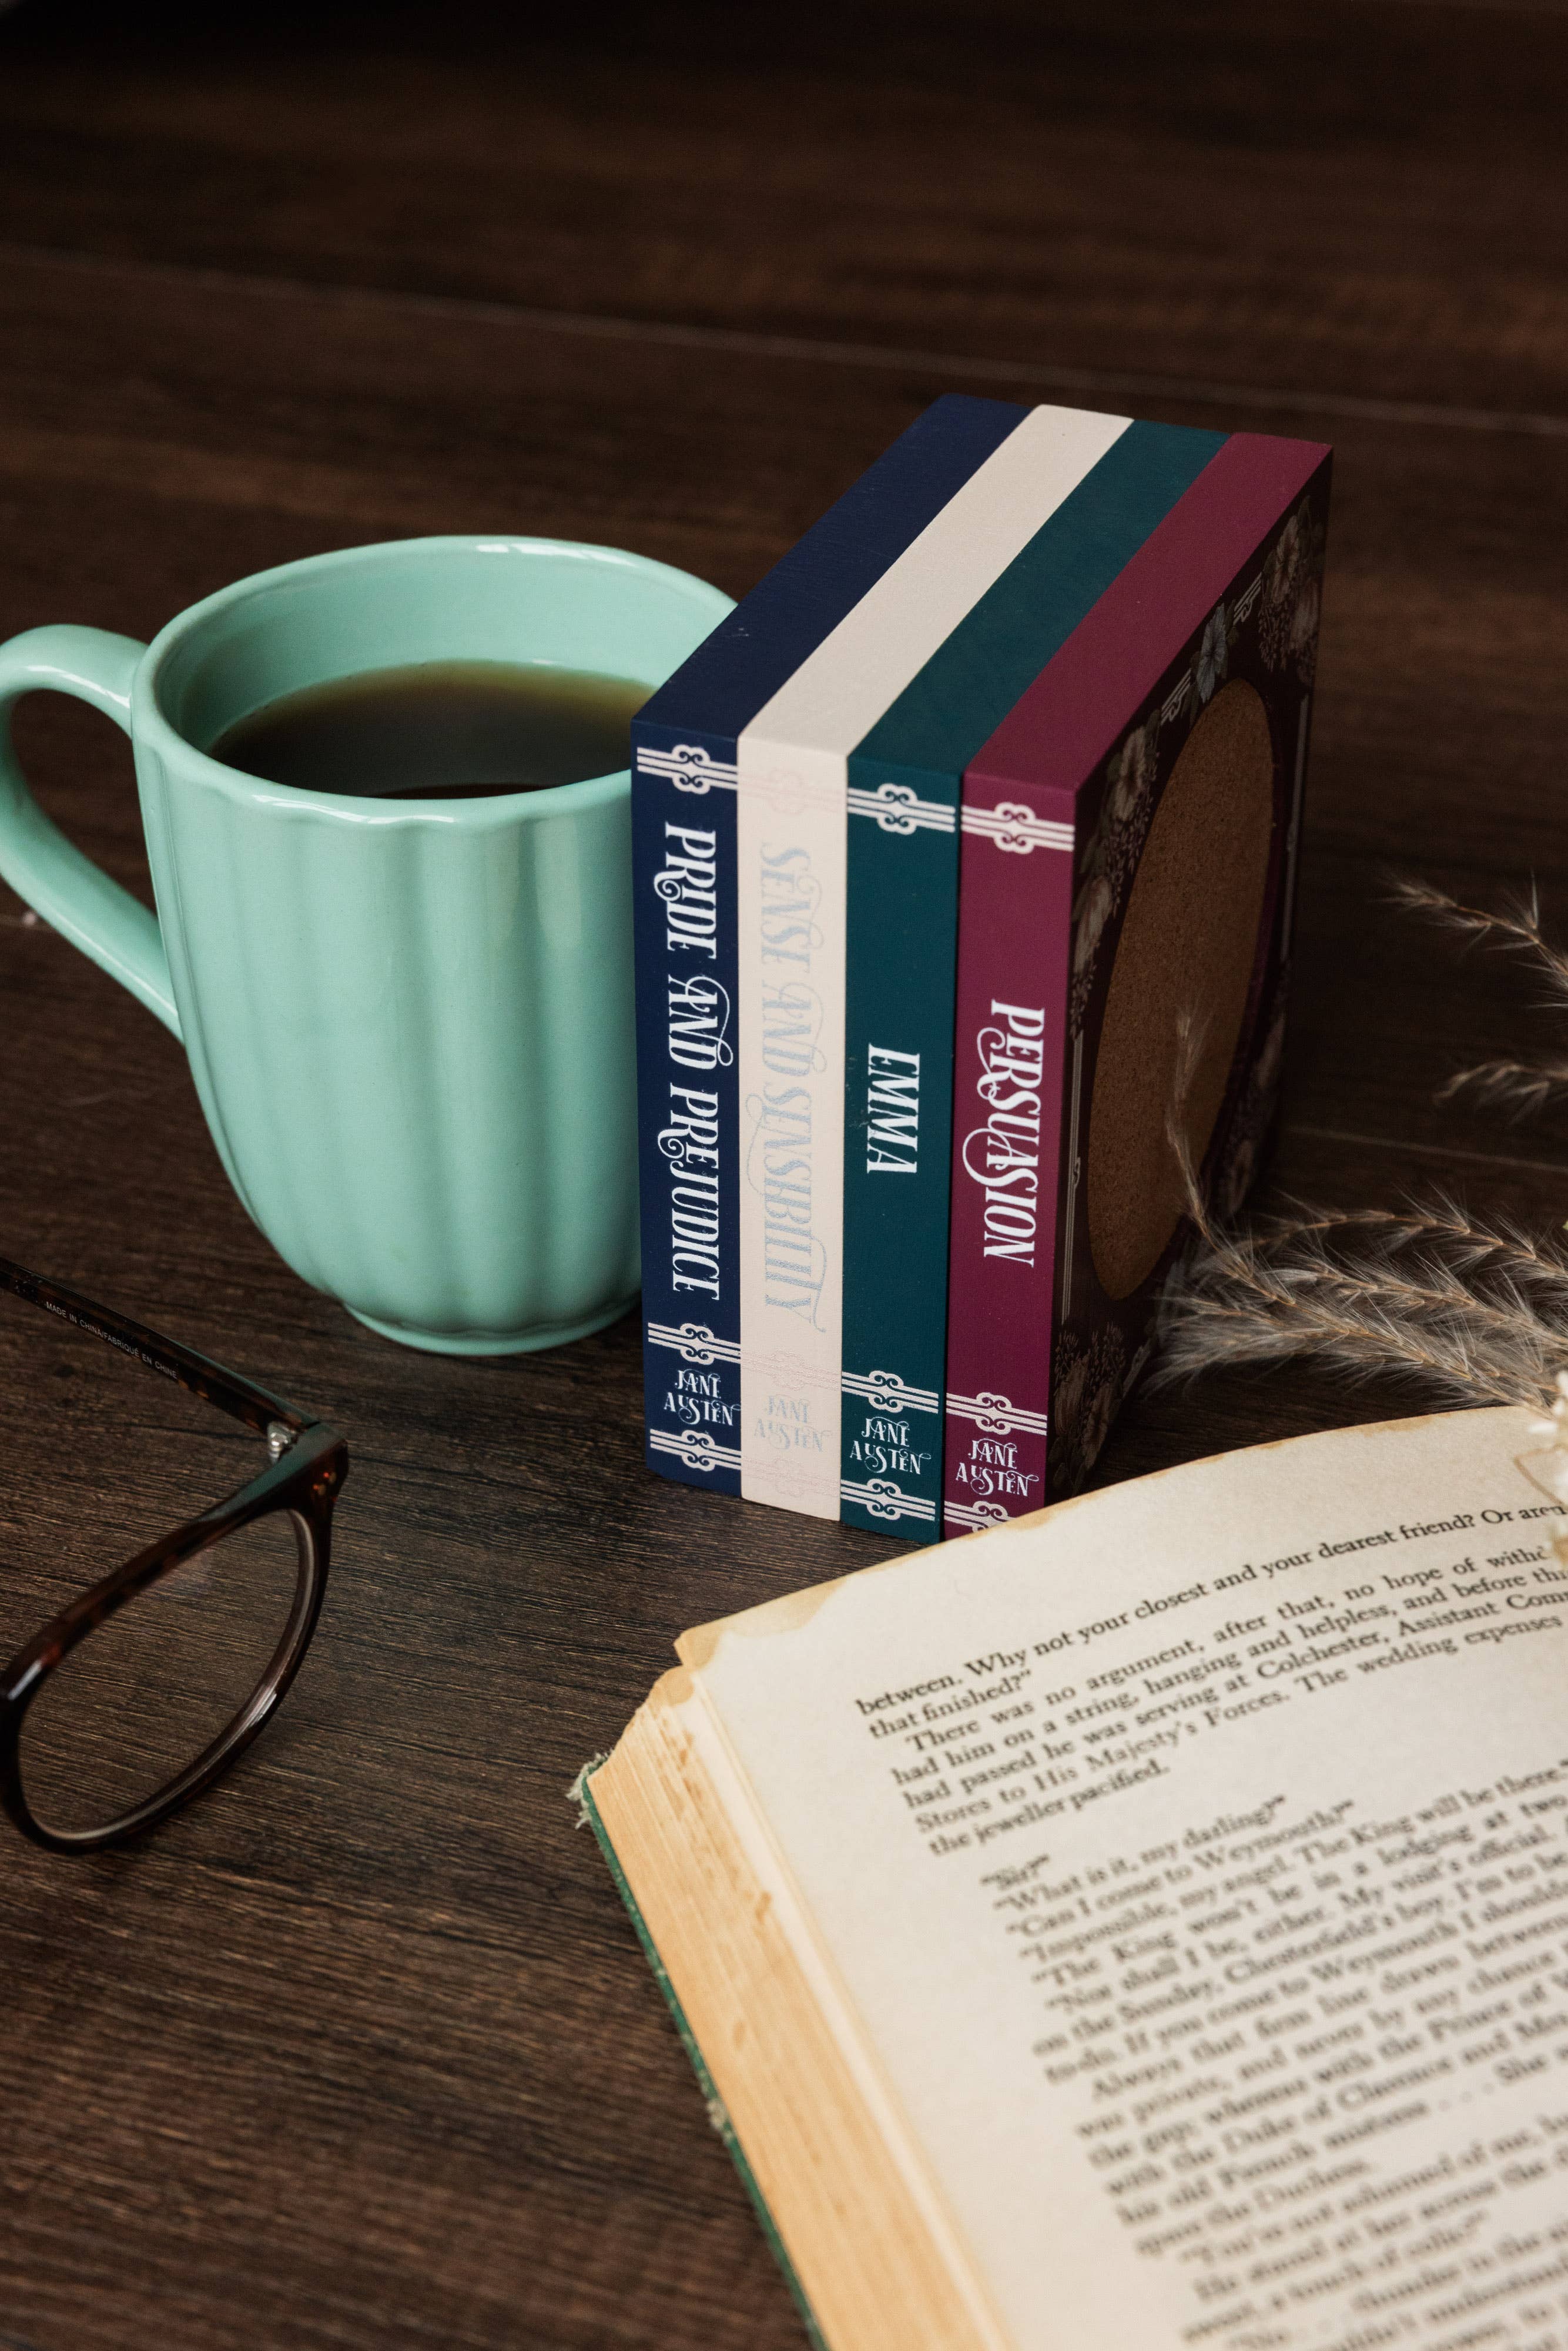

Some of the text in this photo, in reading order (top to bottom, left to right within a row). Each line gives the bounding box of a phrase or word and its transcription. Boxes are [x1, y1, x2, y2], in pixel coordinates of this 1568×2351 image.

[654, 821, 733, 1300] PRIDE AND PREJUDICE
[746, 842, 827, 1333] SENSE AND SENSIBILITY
[867, 1043, 920, 1174] EMMA
[962, 999, 1045, 1268] PERSUASION
[46, 1301, 67, 1318] MADE
[69, 1313, 78, 1324] IN
[141, 1354, 153, 1365] EN
[155, 1361, 177, 1379] CHINE
[675, 1368, 722, 1399] JANE
[663, 1392, 741, 1426] AUSTEN
[850, 1441, 932, 1475] AUSTEN
[862, 1416, 910, 1447] JANE
[968, 1438, 1017, 1469] JANE
[956, 1462, 1039, 1497] AUSTEN
[855, 1675, 963, 1716] between.
[964, 1650, 1026, 1677] Why
[1033, 1632, 1074, 1657] not
[1077, 1612, 1130, 1645] your
[1134, 1583, 1209, 1620] closest
[1213, 1563, 1258, 1591] and
[1261, 1551, 1313, 1579] your
[1318, 1530, 1398, 1559] dearest
[1399, 1513, 1476, 1540] friend?
[1480, 1509, 1514, 1525] Or
[904, 1720, 980, 1752] There
[990, 1701, 1035, 1724] was
[1044, 1686, 1077, 1706] no
[1085, 1639, 1205, 1691] argument,
[1213, 1615, 1267, 1643] after
[1276, 1595, 1335, 1620] that,
[1343, 1585, 1376, 1601] no
[1381, 1568, 1444, 1590] hope
[1452, 1556, 1477, 1575] of
[869, 1712, 919, 1739] that
[890, 1756, 940, 1786] had
[944, 1742, 996, 1768] him
[1003, 1729, 1035, 1748] on
[1043, 1720, 1058, 1734] a
[1064, 1692, 1140, 1726] string,
[1143, 1652, 1243, 1696] hanging
[1247, 1629, 1292, 1658] and
[1295, 1605, 1398, 1640] helpless,
[1402, 1586, 1449, 1610] and
[1450, 1575, 1527, 1598] before
[902, 1590, 1568, 1809] had passed he was serving at Colchester, Assistant Com
[914, 1616, 1563, 1833] Stores to His Majesty's Forces. The wedding expenses
[928, 1758, 1170, 1856] the jeweller pacified.
